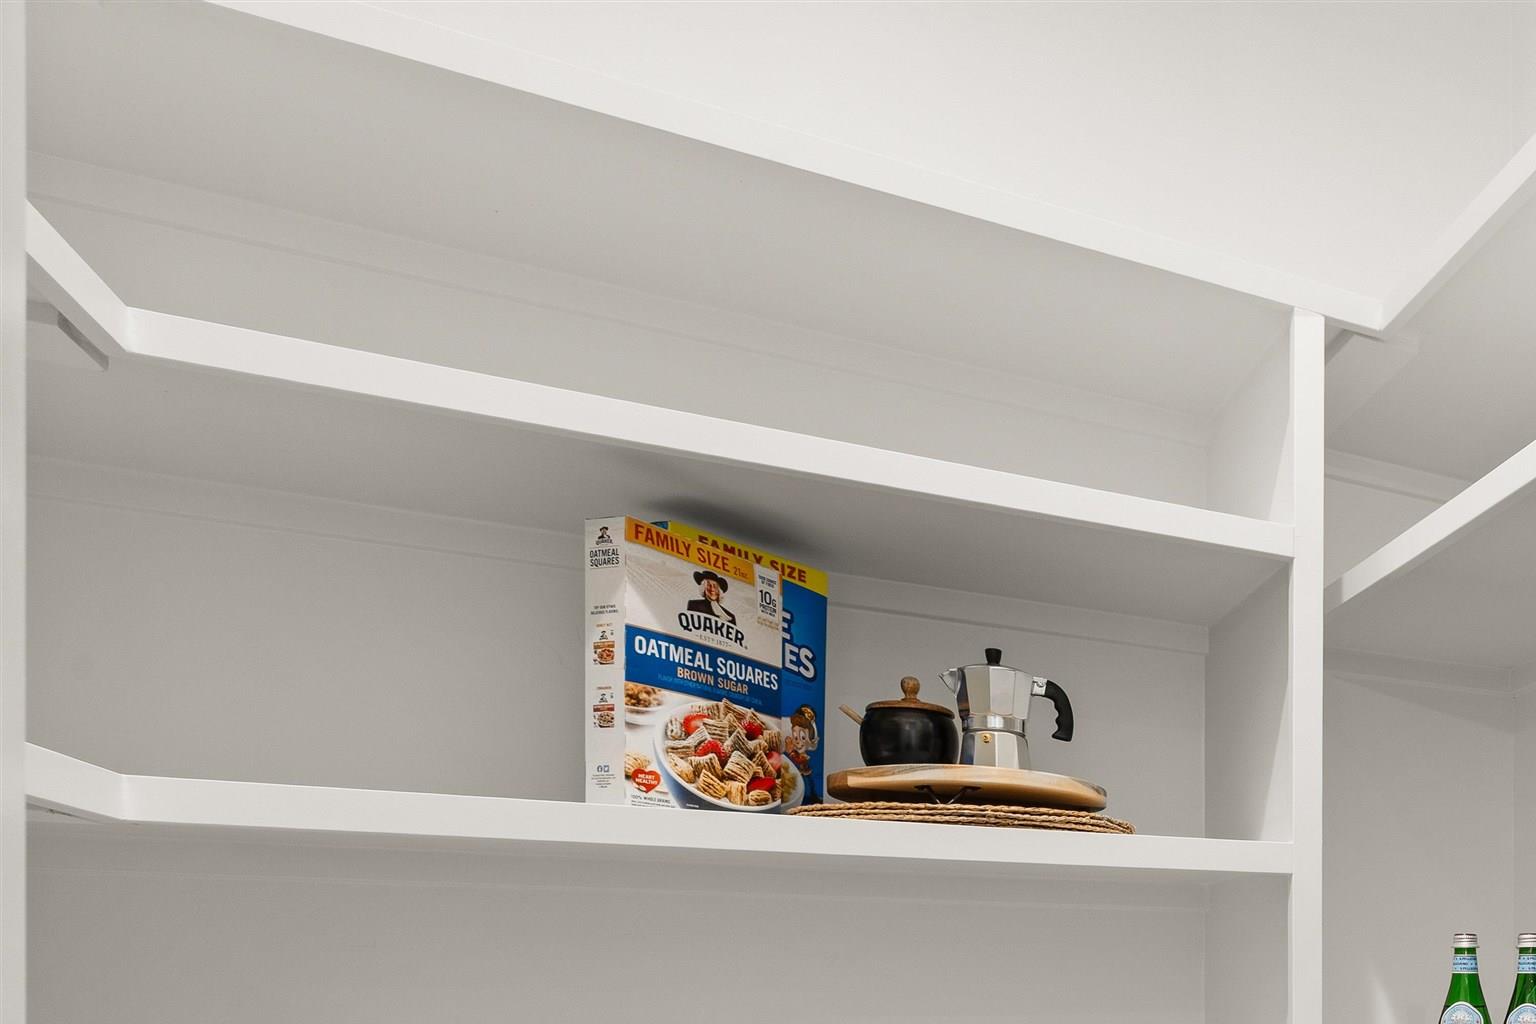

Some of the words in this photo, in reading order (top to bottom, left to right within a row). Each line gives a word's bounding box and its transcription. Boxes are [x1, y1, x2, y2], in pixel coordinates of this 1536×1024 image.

[589, 548, 619, 558] OATMEAL
[634, 523, 692, 558] FAMILY
[696, 547, 730, 573] SIZE
[589, 557, 620, 568] SQUARES
[770, 559, 807, 584] SIZE
[677, 613, 745, 648] QUAKER
[634, 635, 713, 671] OATMEAL
[716, 657, 779, 691] SQUARES
[677, 667, 714, 686] BROWN
[717, 678, 749, 695] SUGAR
